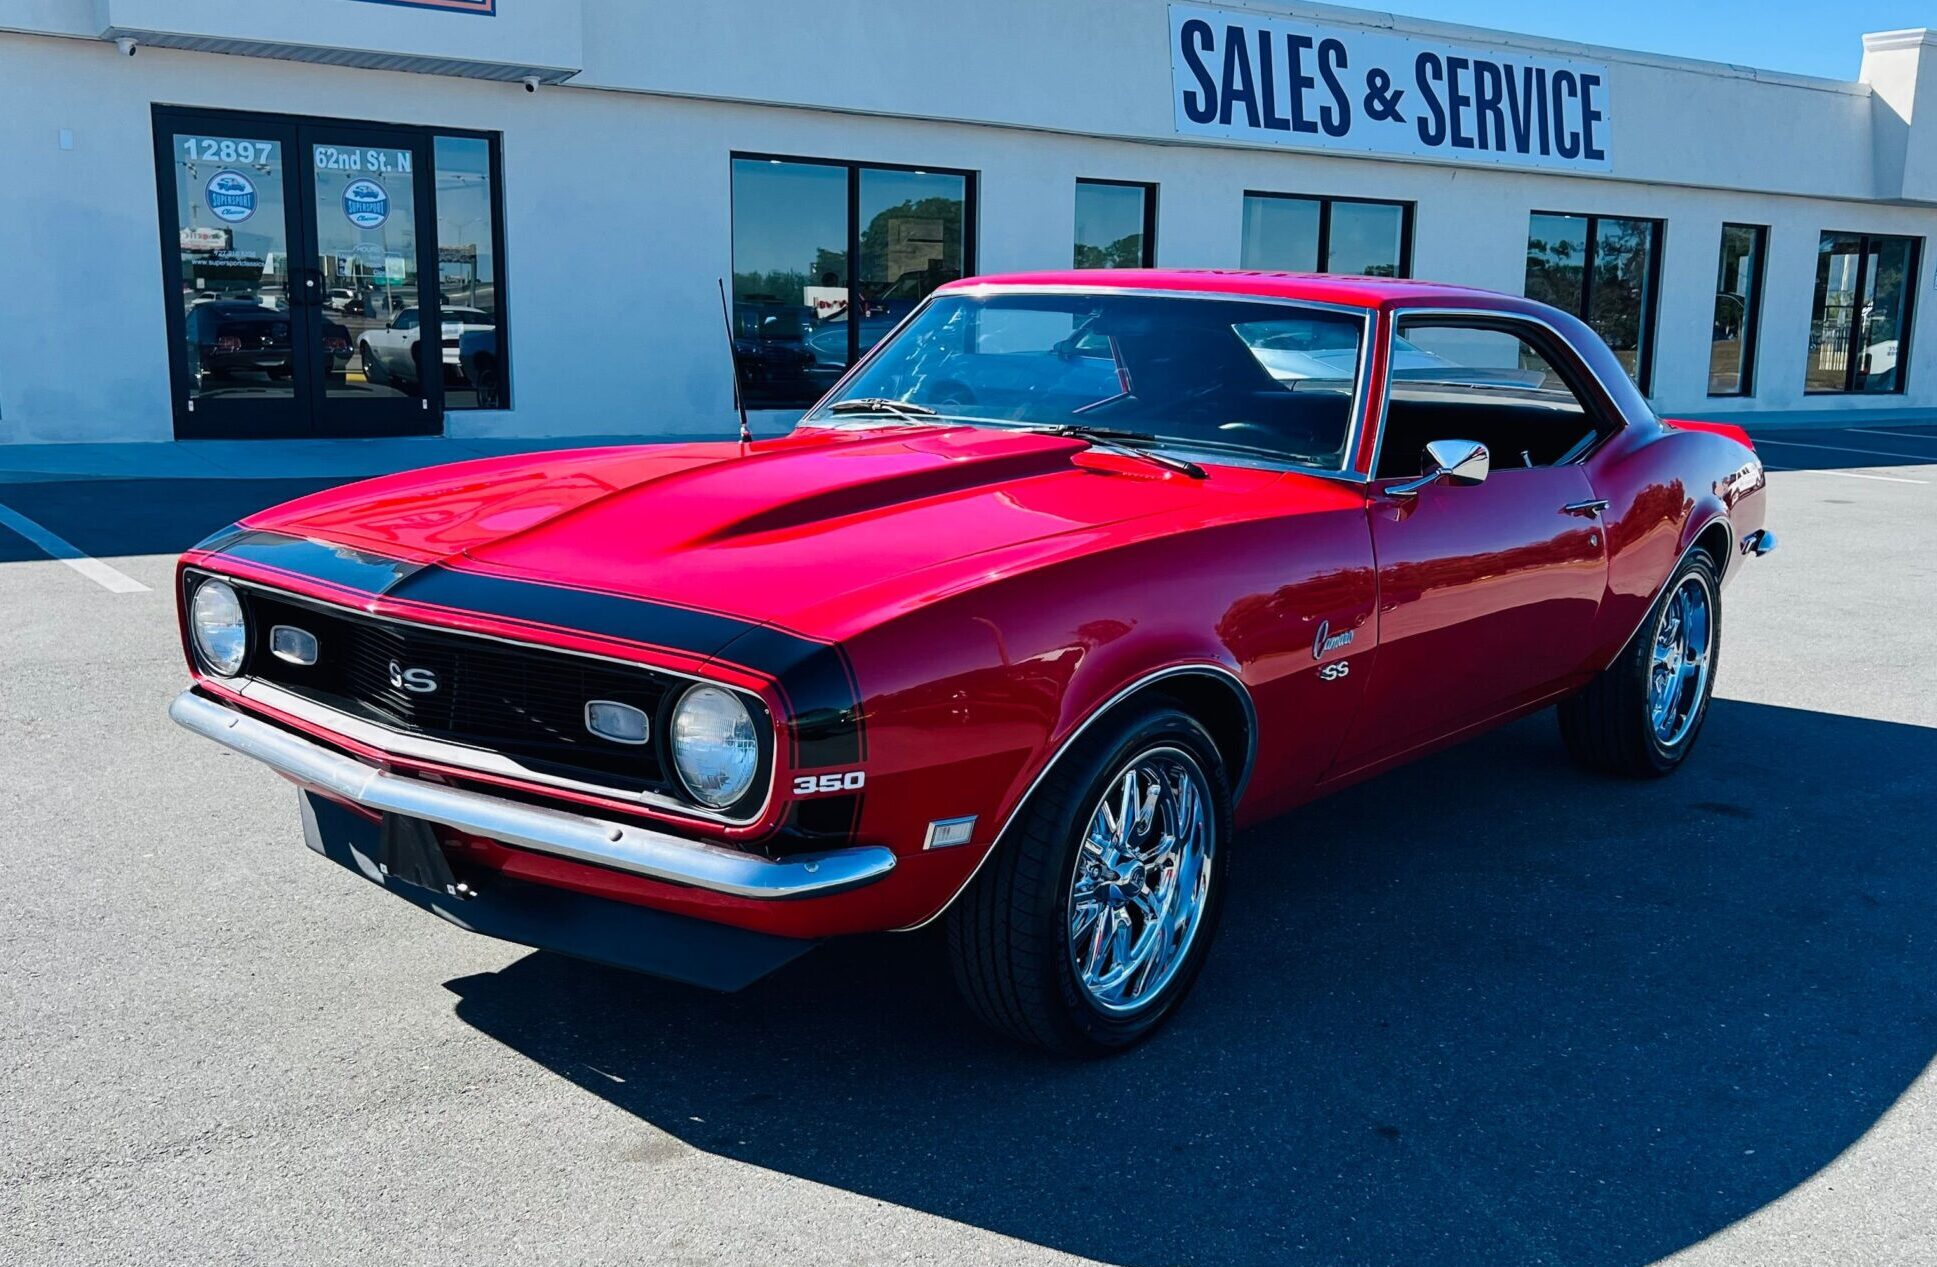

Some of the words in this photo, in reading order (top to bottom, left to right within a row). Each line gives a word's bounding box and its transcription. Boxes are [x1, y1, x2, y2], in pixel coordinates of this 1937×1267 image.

[1180, 19, 1351, 137] SALES
[1363, 68, 1407, 123] &
[1415, 52, 1605, 161] SERVICE
[184, 138, 272, 164] 12897
[315, 147, 360, 170] 62nd
[366, 150, 391, 171] St.
[397, 152, 411, 172] N
[212, 192, 251, 208] SUPERSPORT
[348, 200, 384, 214] SUPERSPORT
[389, 661, 437, 693] SS
[1320, 661, 1349, 681] SS
[793, 771, 865, 795] 350
